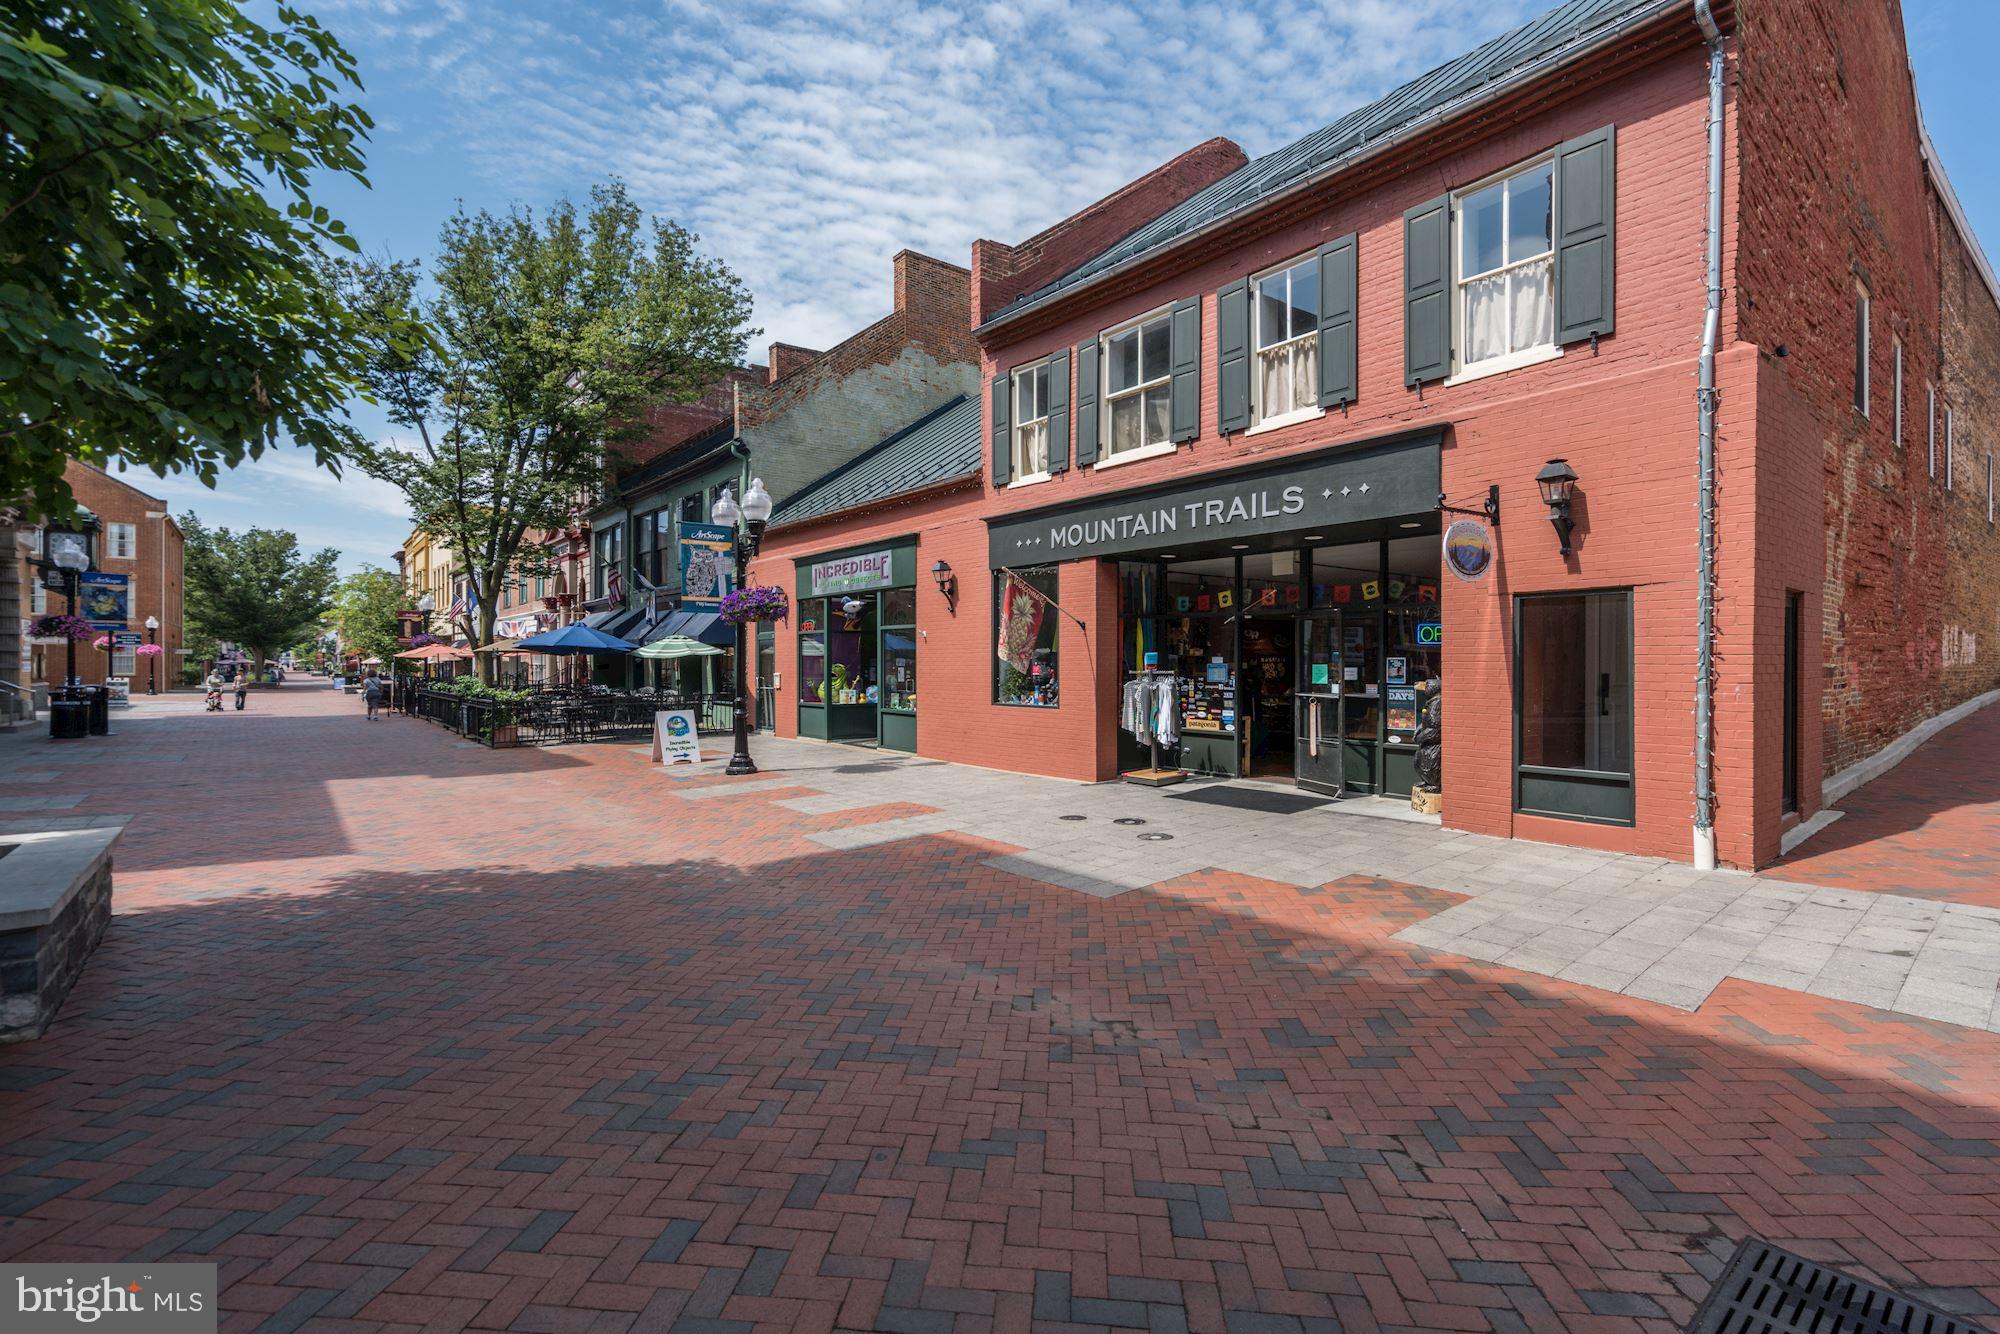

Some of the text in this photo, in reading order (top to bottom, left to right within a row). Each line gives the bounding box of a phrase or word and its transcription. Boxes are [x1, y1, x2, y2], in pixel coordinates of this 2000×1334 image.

[1050, 485, 1304, 549] MOUNTAIN TRAILS
[690, 529, 726, 541] ArtScape
[814, 554, 889, 588] INCREDIBLE
[1388, 692, 1415, 701] DAYS
